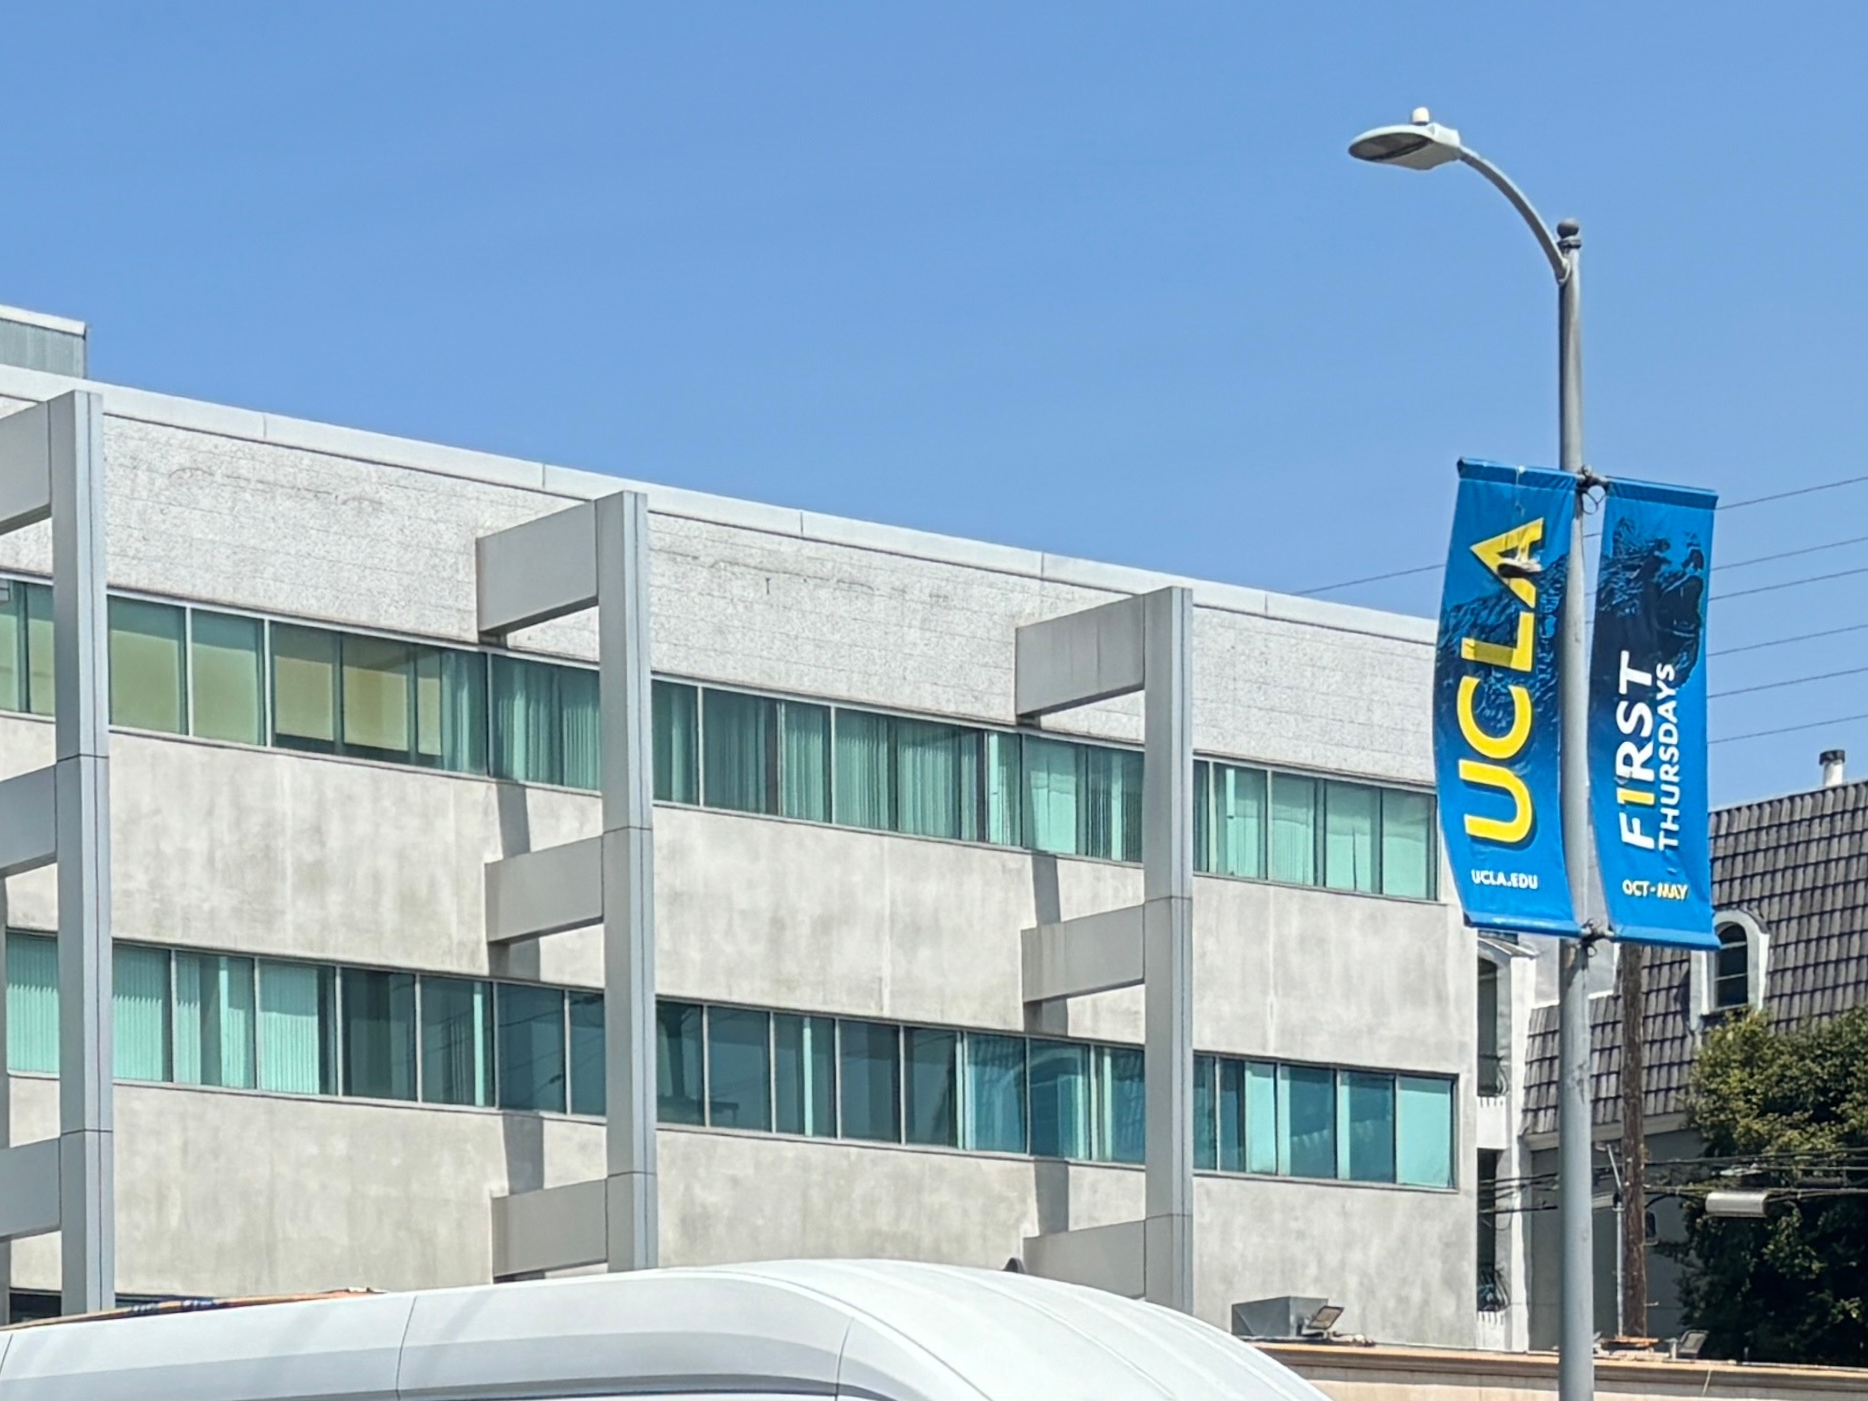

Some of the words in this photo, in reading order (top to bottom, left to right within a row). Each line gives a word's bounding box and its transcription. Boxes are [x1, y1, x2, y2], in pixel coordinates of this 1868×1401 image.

[1456, 517, 1544, 844] UCLA
[1656, 662, 1681, 851] THURSDAYS
[1471, 868, 1539, 889] UCLA.EDU
